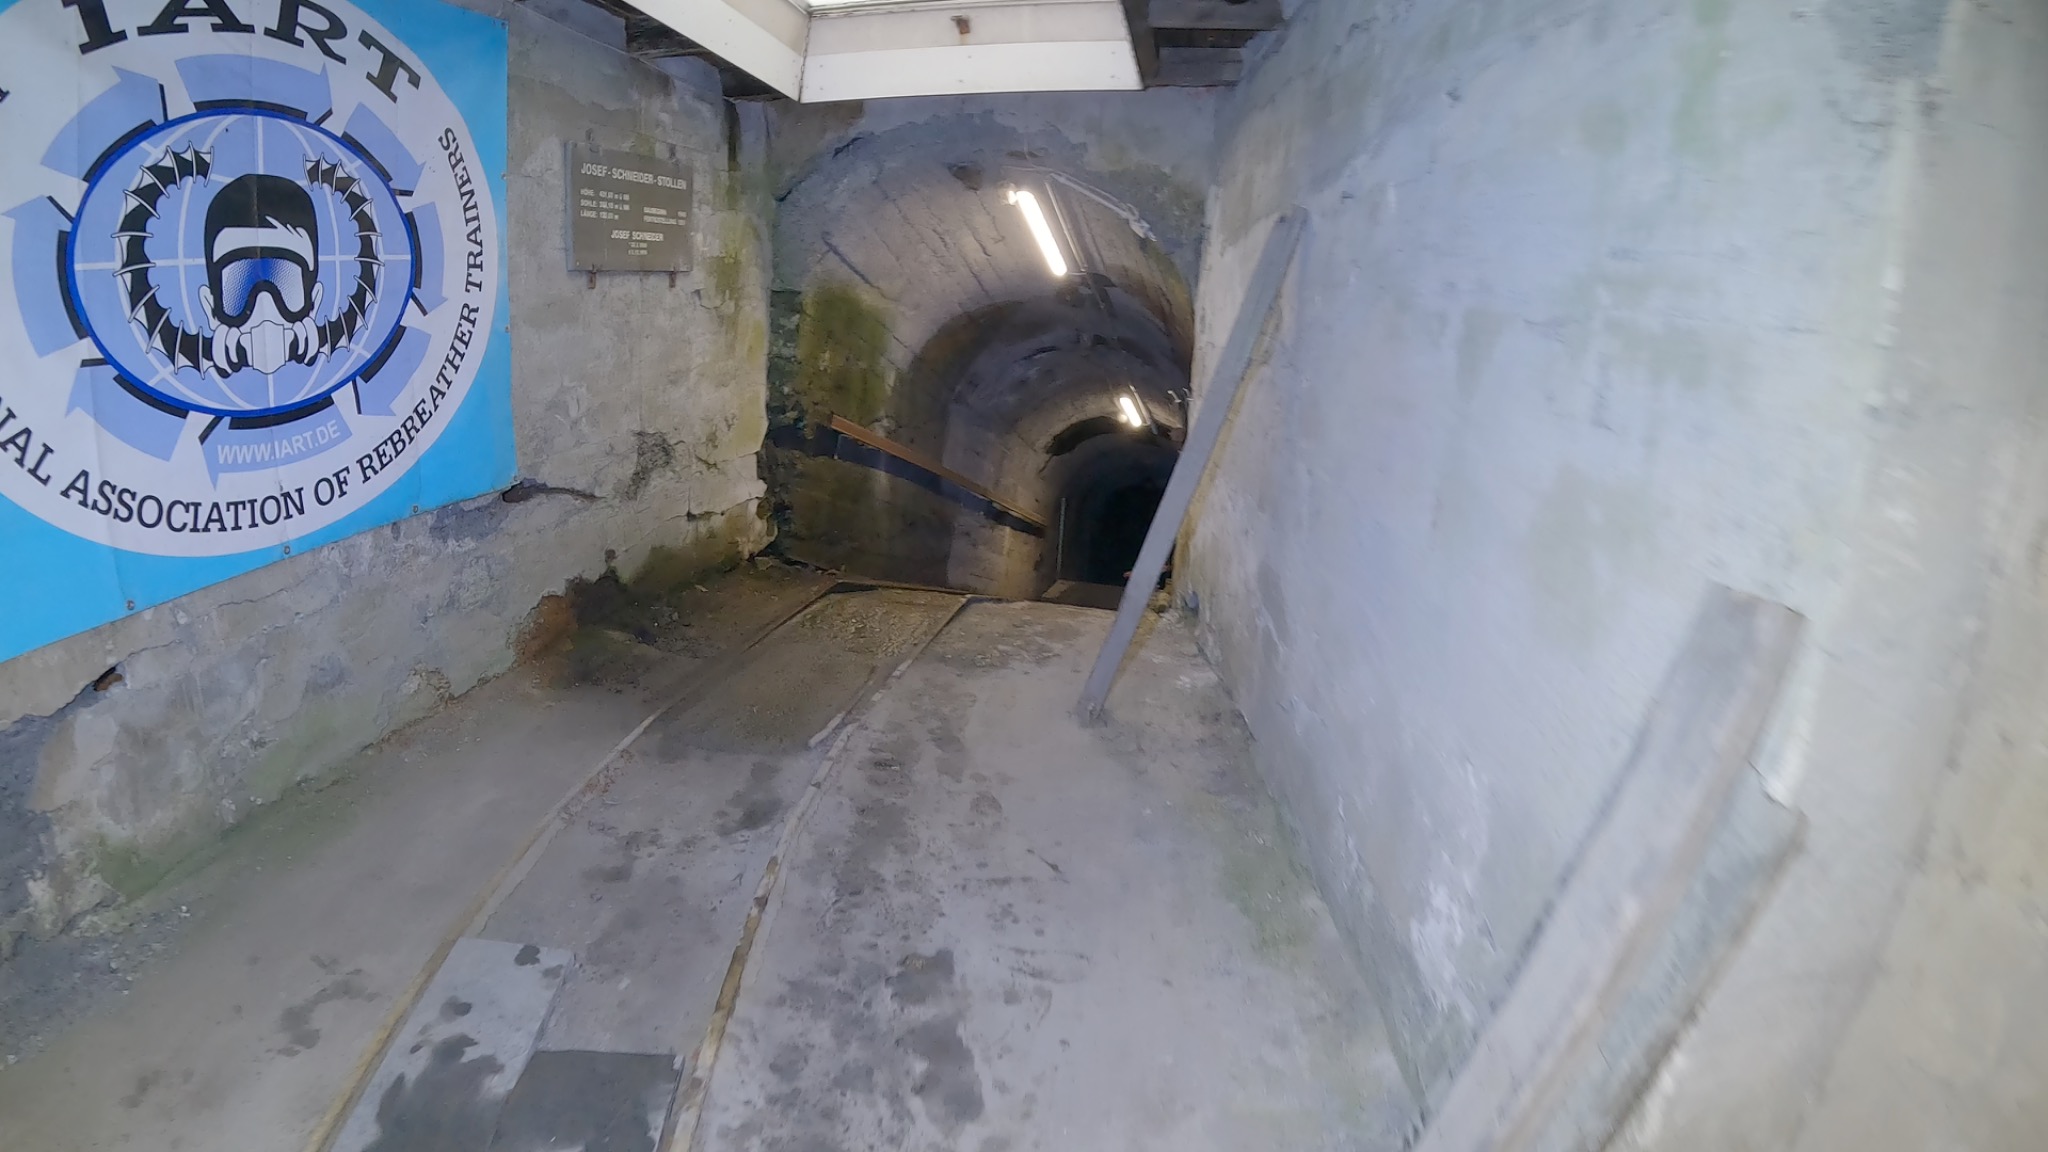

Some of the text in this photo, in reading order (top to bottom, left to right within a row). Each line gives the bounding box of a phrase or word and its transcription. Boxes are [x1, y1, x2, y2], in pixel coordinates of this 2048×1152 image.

[62, 0, 421, 104] IART
[611, 229, 630, 239] JOSEF
[61, 469, 306, 533] ASSOCIATION
[313, 466, 351, 506] OF
[362, 303, 480, 484] REBREATHER
[438, 127, 484, 293] TRAINERS
[217, 422, 341, 465] WWW.IART.DE
